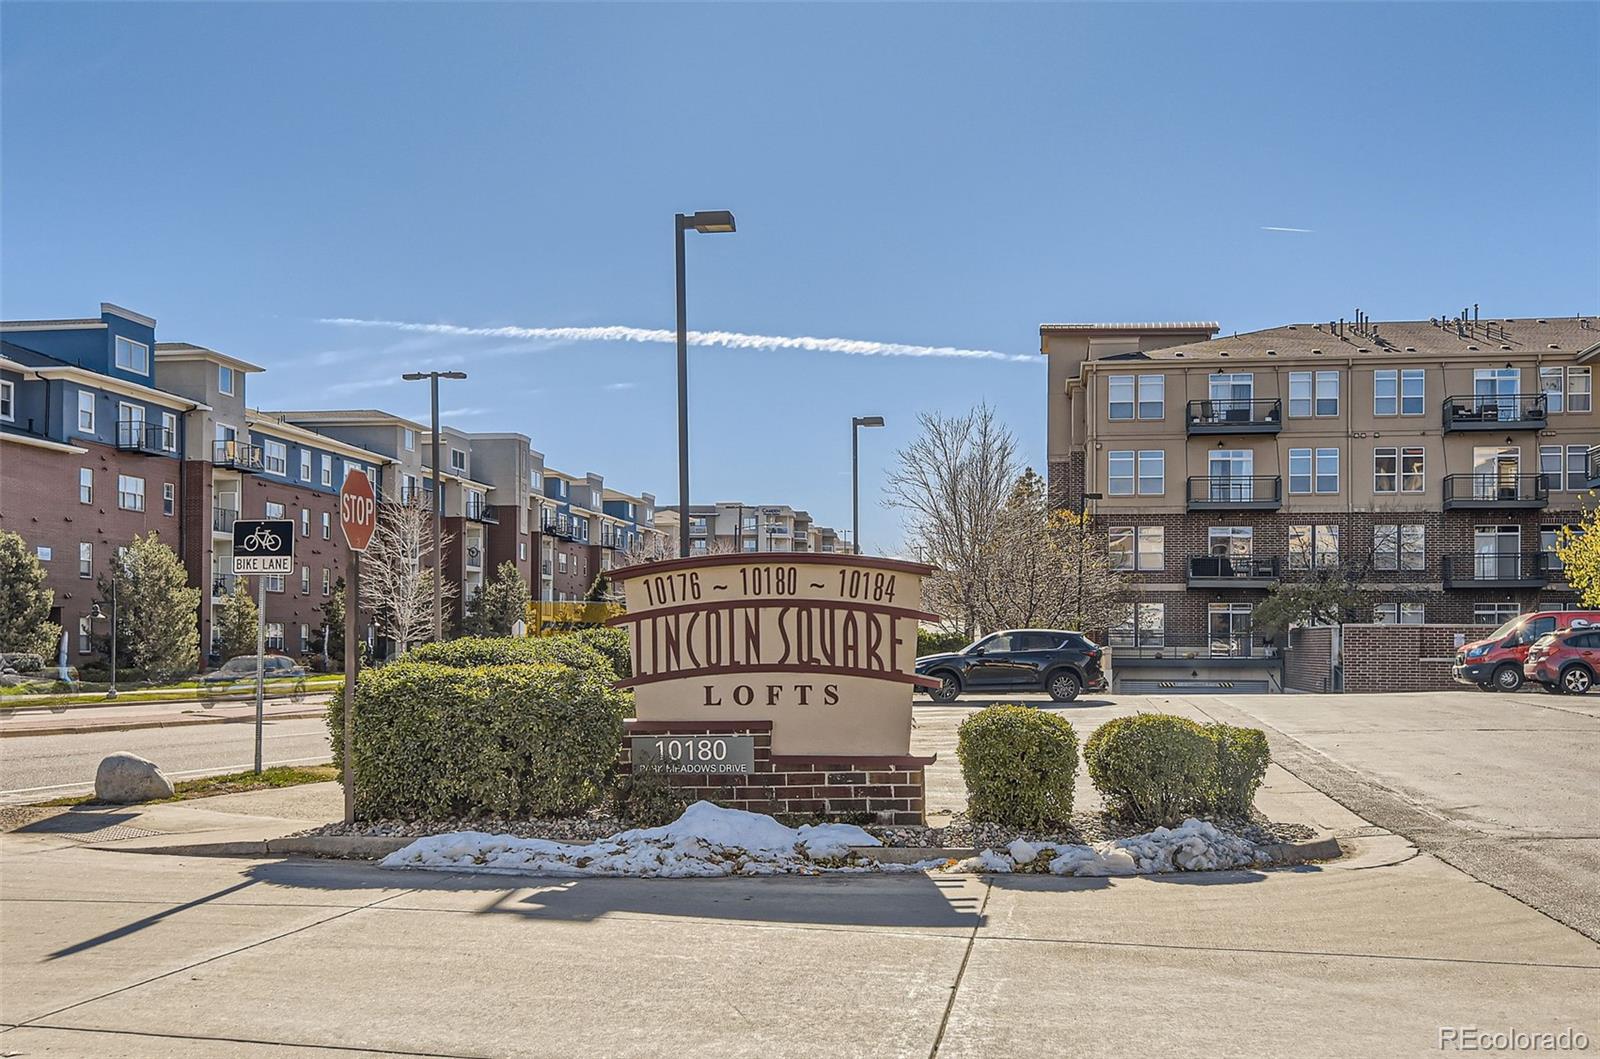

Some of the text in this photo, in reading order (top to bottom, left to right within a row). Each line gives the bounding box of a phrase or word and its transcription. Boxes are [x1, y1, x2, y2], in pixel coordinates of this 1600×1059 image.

[343, 493, 373, 526] STOP
[236, 558, 289, 570] BIKE LANE
[643, 572, 701, 606] 10176
[740, 567, 797, 596] 10180
[839, 569, 896, 603] 10184
[635, 607, 903, 676] LINCOLN SQUARE
[704, 684, 839, 706] LOFTS
[655, 740, 727, 761] 10180
[719, 764, 747, 773] DRIVE
